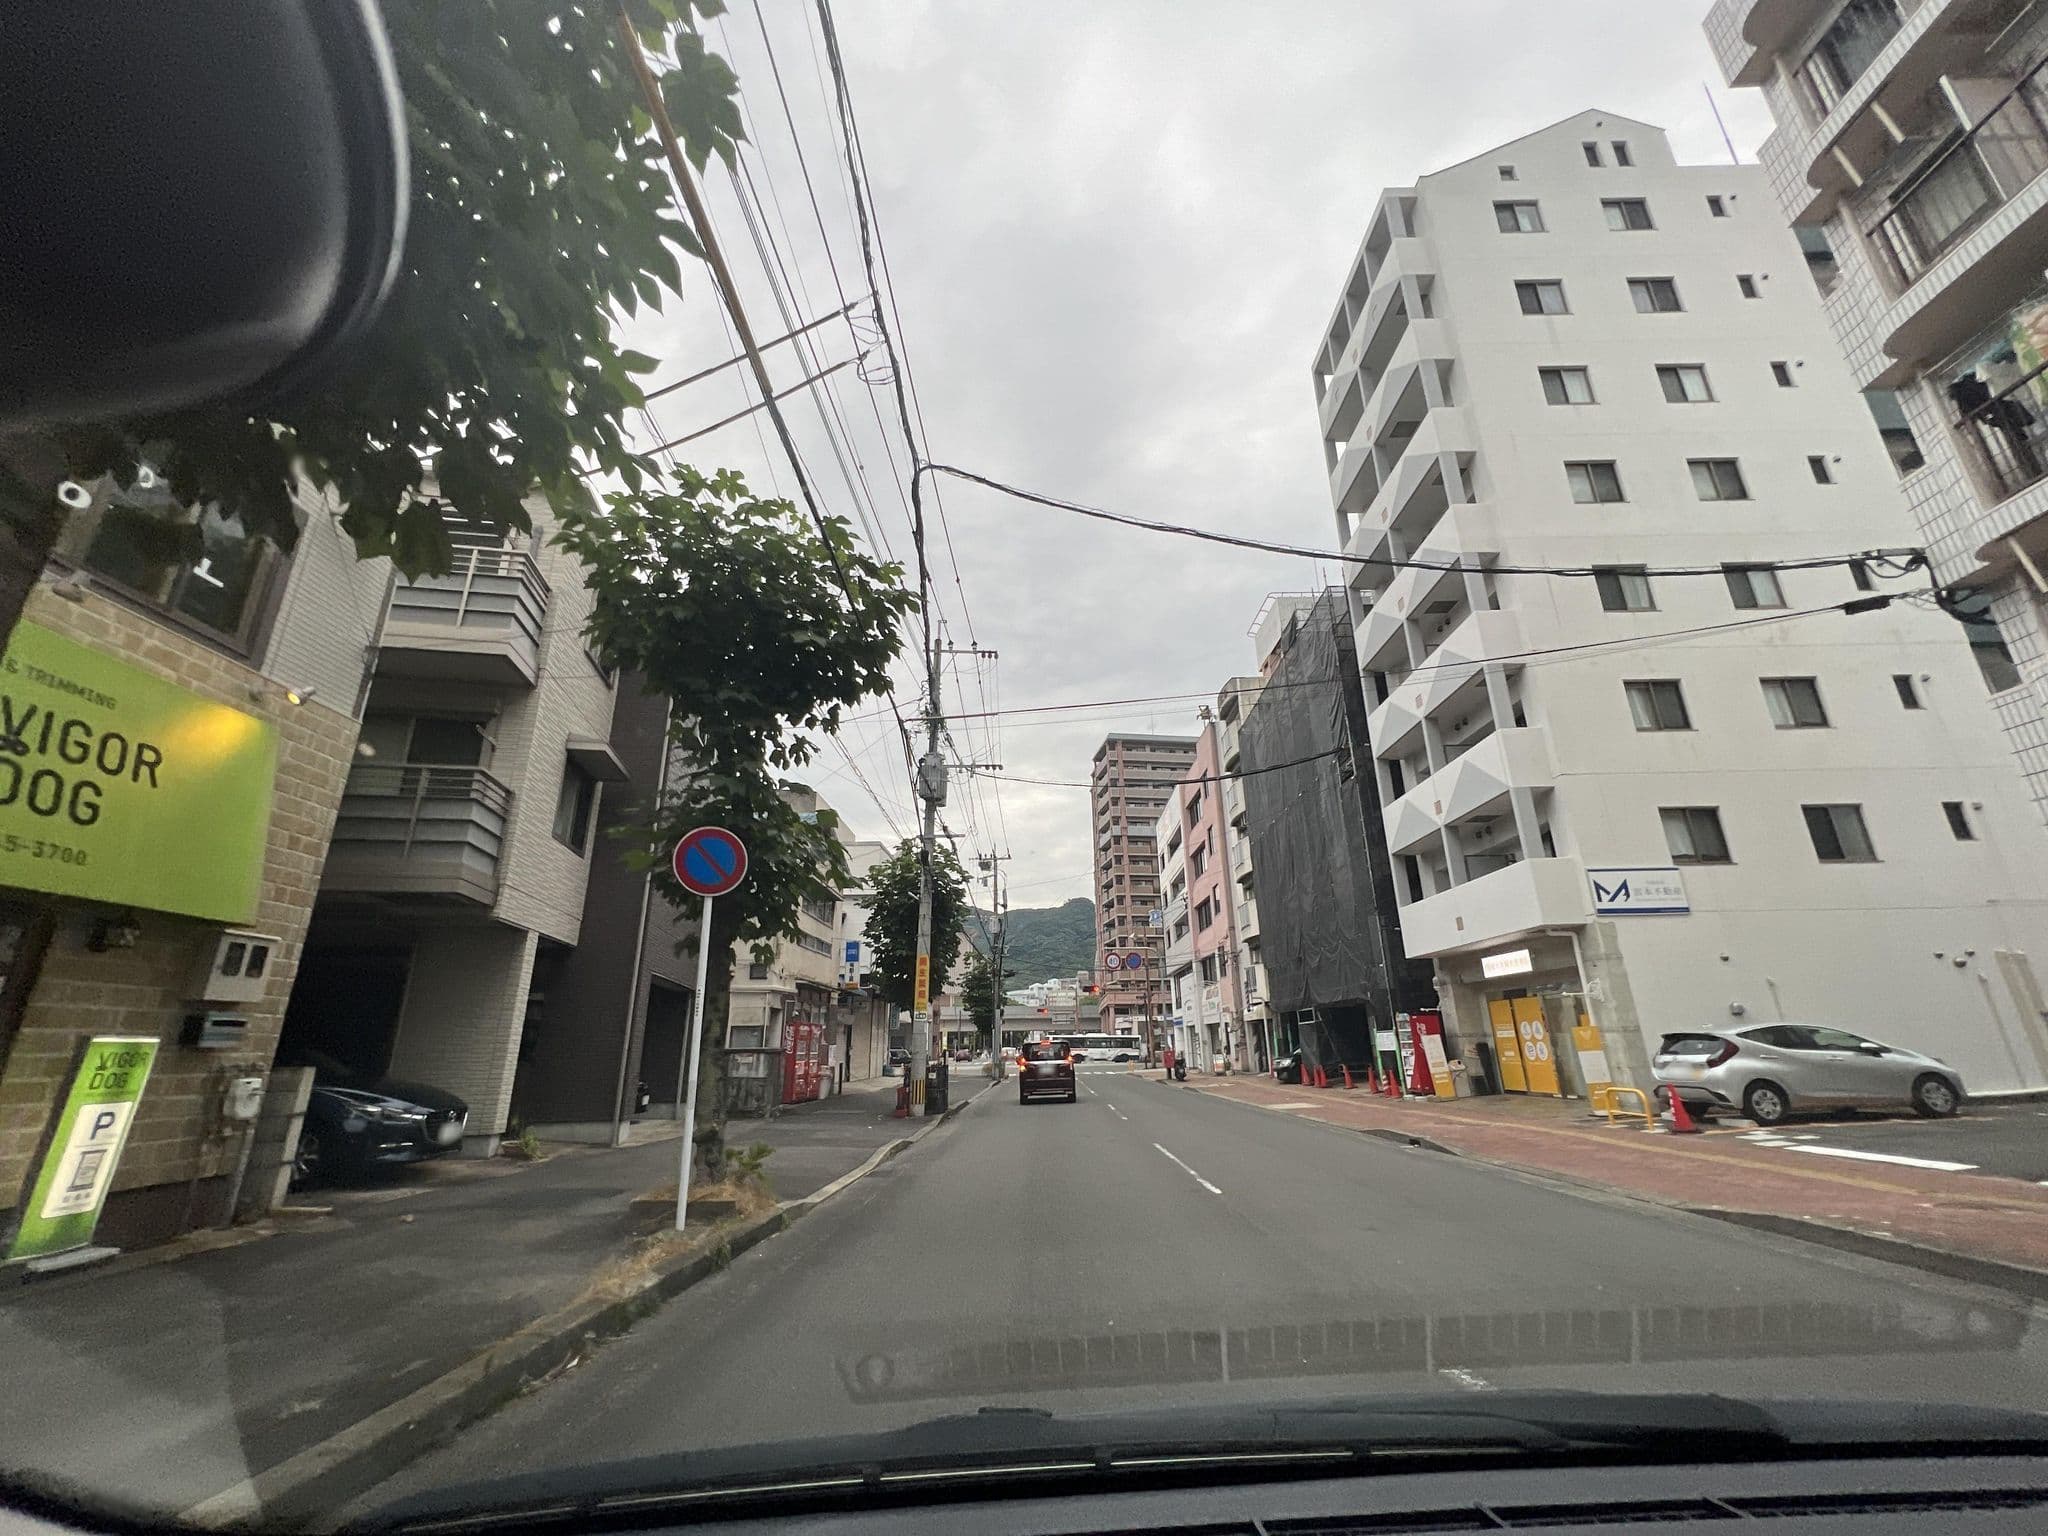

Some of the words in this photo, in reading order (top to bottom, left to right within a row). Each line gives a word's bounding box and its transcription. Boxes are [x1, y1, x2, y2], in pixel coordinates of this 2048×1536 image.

[27, 664, 118, 710] TRIMMING
[1, 694, 164, 789] VIGOR
[0, 757, 103, 826] DOG
[1109, 956, 1118, 966] 40
[88, 1072, 129, 1090] DOG
[89, 1111, 116, 1140] P
